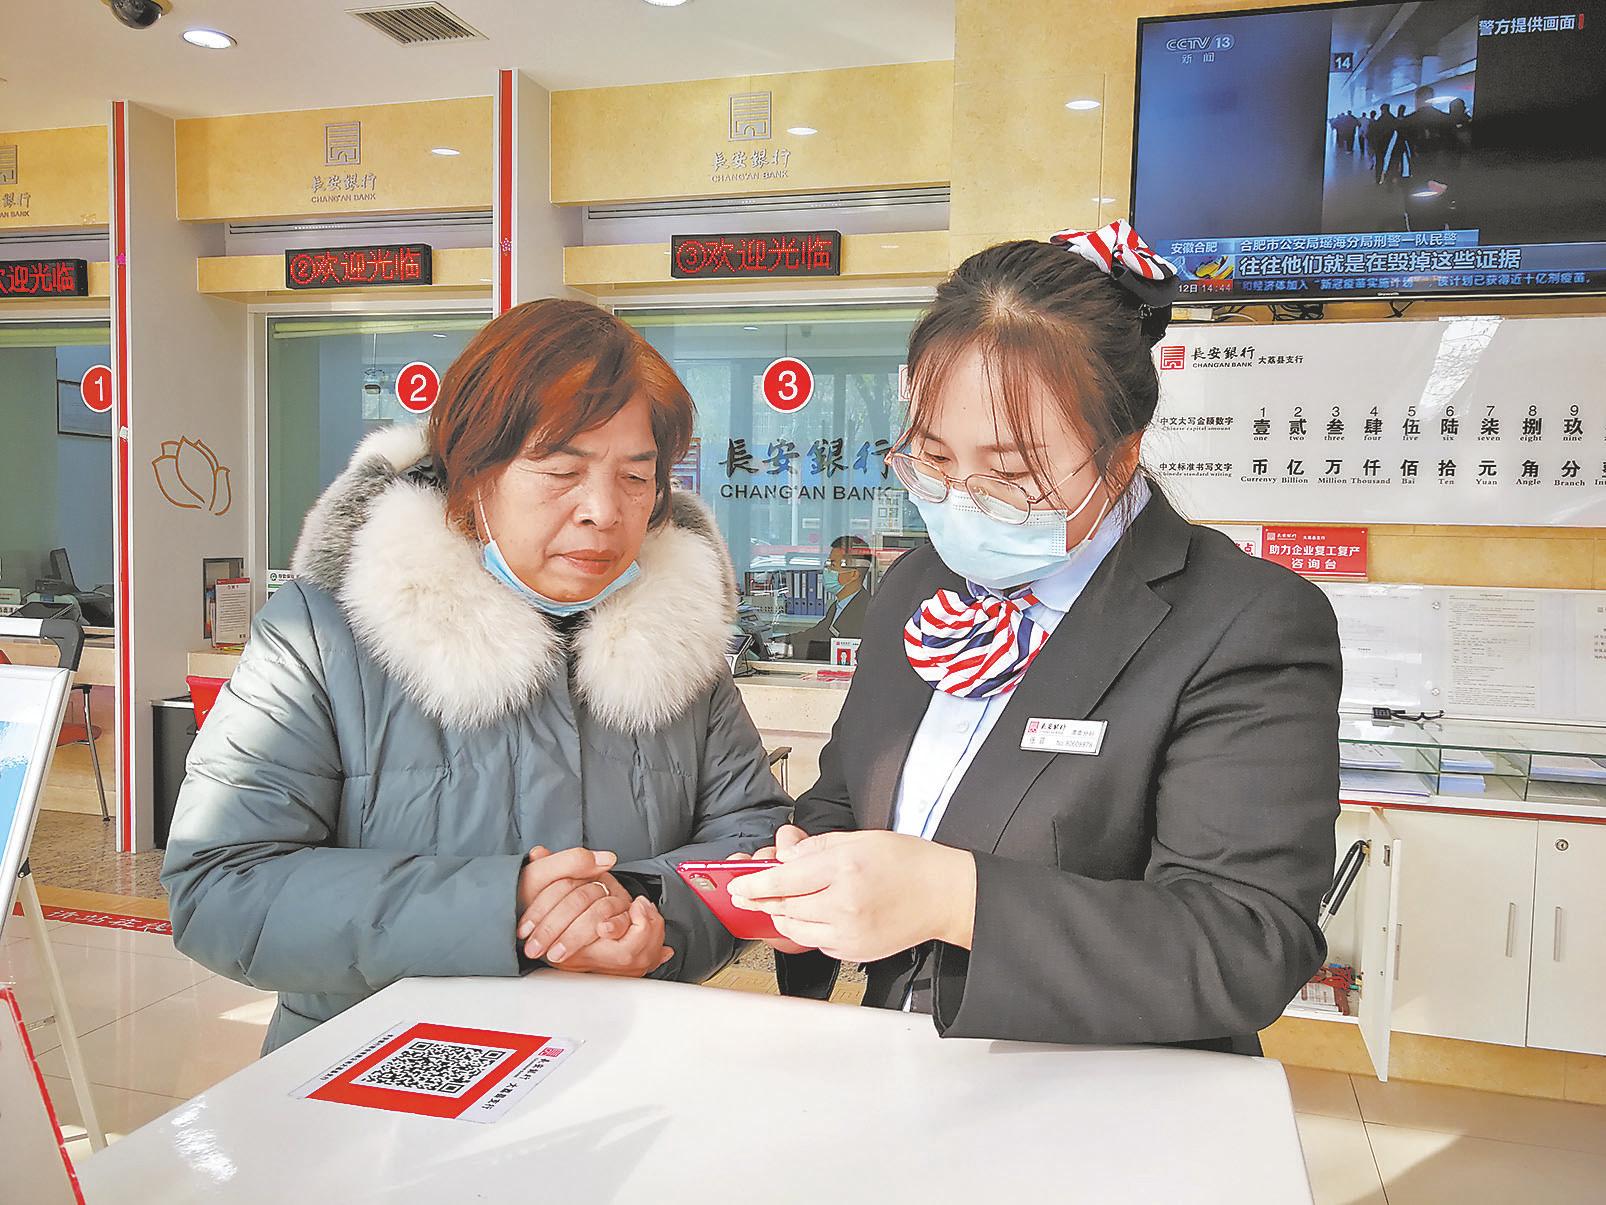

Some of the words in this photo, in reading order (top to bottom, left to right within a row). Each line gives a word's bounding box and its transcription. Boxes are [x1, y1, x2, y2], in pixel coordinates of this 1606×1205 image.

[1479, 14, 1576, 36] 警方提供画面
[1167, 36, 1210, 50] CCTV
[1215, 37, 1231, 49] 13
[1335, 56, 1351, 69] 14
[763, 170, 789, 180] BANK
[354, 192, 377, 202] BANK
[1171, 241, 1218, 254] 安徽合肥
[1240, 232, 1457, 252] 合肥市公安局瑶海分局刑警一队民警
[1239, 249, 1521, 276] 往往他们就是在毁掉这些证据
[1191, 345, 1256, 361] 長安銀行
[1258, 355, 1304, 365] 大荔县支行
[95, 376, 104, 402] 1
[410, 373, 427, 402] 2
[777, 370, 798, 401] 3
[1294, 406, 1303, 417] 2
[1332, 406, 1340, 417] 3
[1370, 406, 1379, 417] 4
[1408, 406, 1416, 417] 5
[1446, 406, 1454, 417] 6
[1486, 406, 1495, 416] 7
[1529, 405, 1537, 416] 8
[1570, 405, 1579, 416] 9
[1160, 416, 1233, 425] 中文大写金额数字
[1253, 419, 1271, 435] 壹
[1289, 419, 1307, 435] 贰
[1364, 418, 1383, 435] 肆
[1402, 418, 1421, 436] 伍
[1441, 418, 1459, 435] 陆
[1481, 418, 1500, 435] 柒
[1522, 418, 1542, 435] 捌
[1563, 418, 1583, 435] 玖
[718, 437, 893, 480] 長安銀行
[1159, 462, 1232, 471] 中文标准书写文字
[1252, 459, 1269, 476] 币
[1287, 459, 1305, 476] 亿
[1325, 459, 1343, 475] 万
[1363, 459, 1381, 476] 仟
[1400, 459, 1419, 476] 佰
[1438, 459, 1457, 476] 拾
[1478, 460, 1497, 476] 元
[1521, 460, 1539, 477] 角
[1561, 460, 1581, 477] 分
[834, 485, 893, 501] BANK
[1269, 544, 1360, 557] 助力企业复工复产
[1291, 558, 1337, 569] 咨询台
